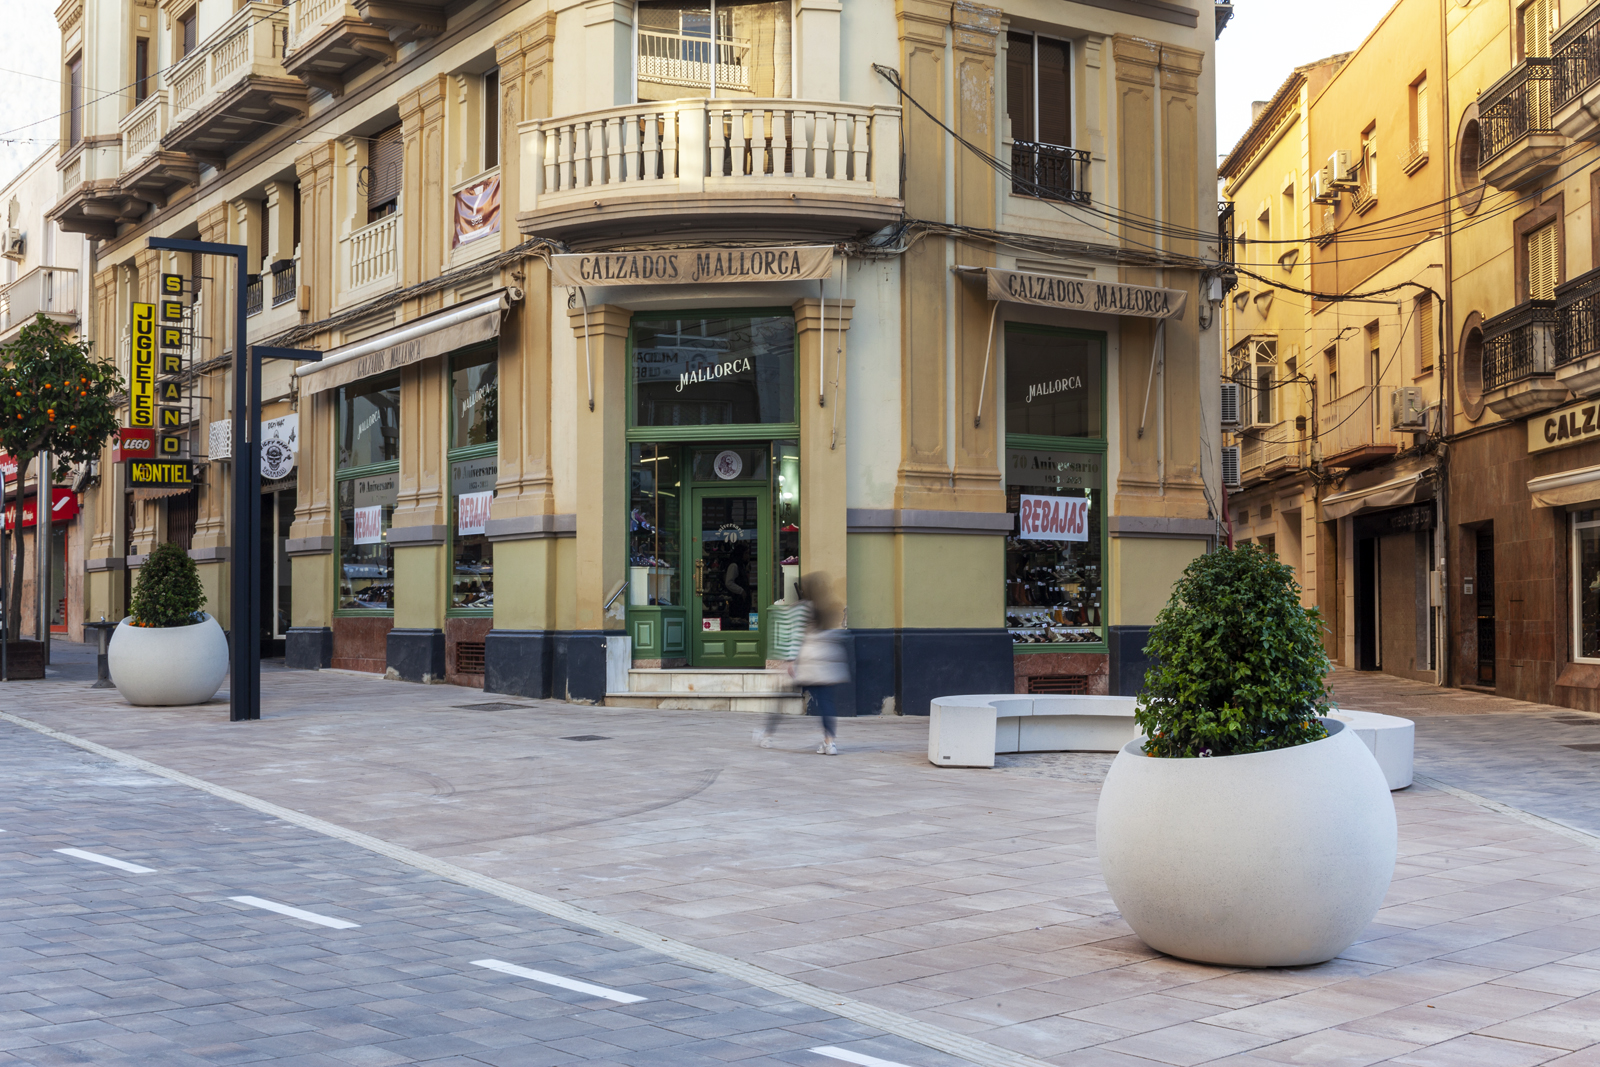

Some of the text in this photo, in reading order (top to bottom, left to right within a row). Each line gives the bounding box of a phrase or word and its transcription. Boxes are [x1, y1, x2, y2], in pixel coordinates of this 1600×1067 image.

[580, 250, 801, 282] CALZADOS MALLORCA
[1008, 274, 1171, 314] CALZADOS MALLORCA
[135, 306, 153, 424] JUGUETES
[164, 276, 181, 452] SERRANO
[357, 340, 421, 377] CALZADOS MALLORCA
[675, 357, 751, 393] MALLORCA
[1026, 375, 1082, 403] MALLORCA
[461, 383, 490, 418] MALLORCA
[357, 409, 380, 440] MALLORCA
[1544, 403, 1600, 443] CALZ
[123, 439, 151, 450] LEGO
[132, 463, 192, 483] MONTIEL
[453, 461, 497, 480] 70 Aniversario
[1012, 454, 1099, 473] 70 Aniversario
[359, 477, 395, 494] 70 Aniversario
[354, 508, 381, 541] REBAJAS
[459, 494, 493, 530] REBAJAS
[1021, 499, 1087, 535] REBAJAS
[715, 523, 745, 538] Aniversario
[723, 531, 738, 543] 70
